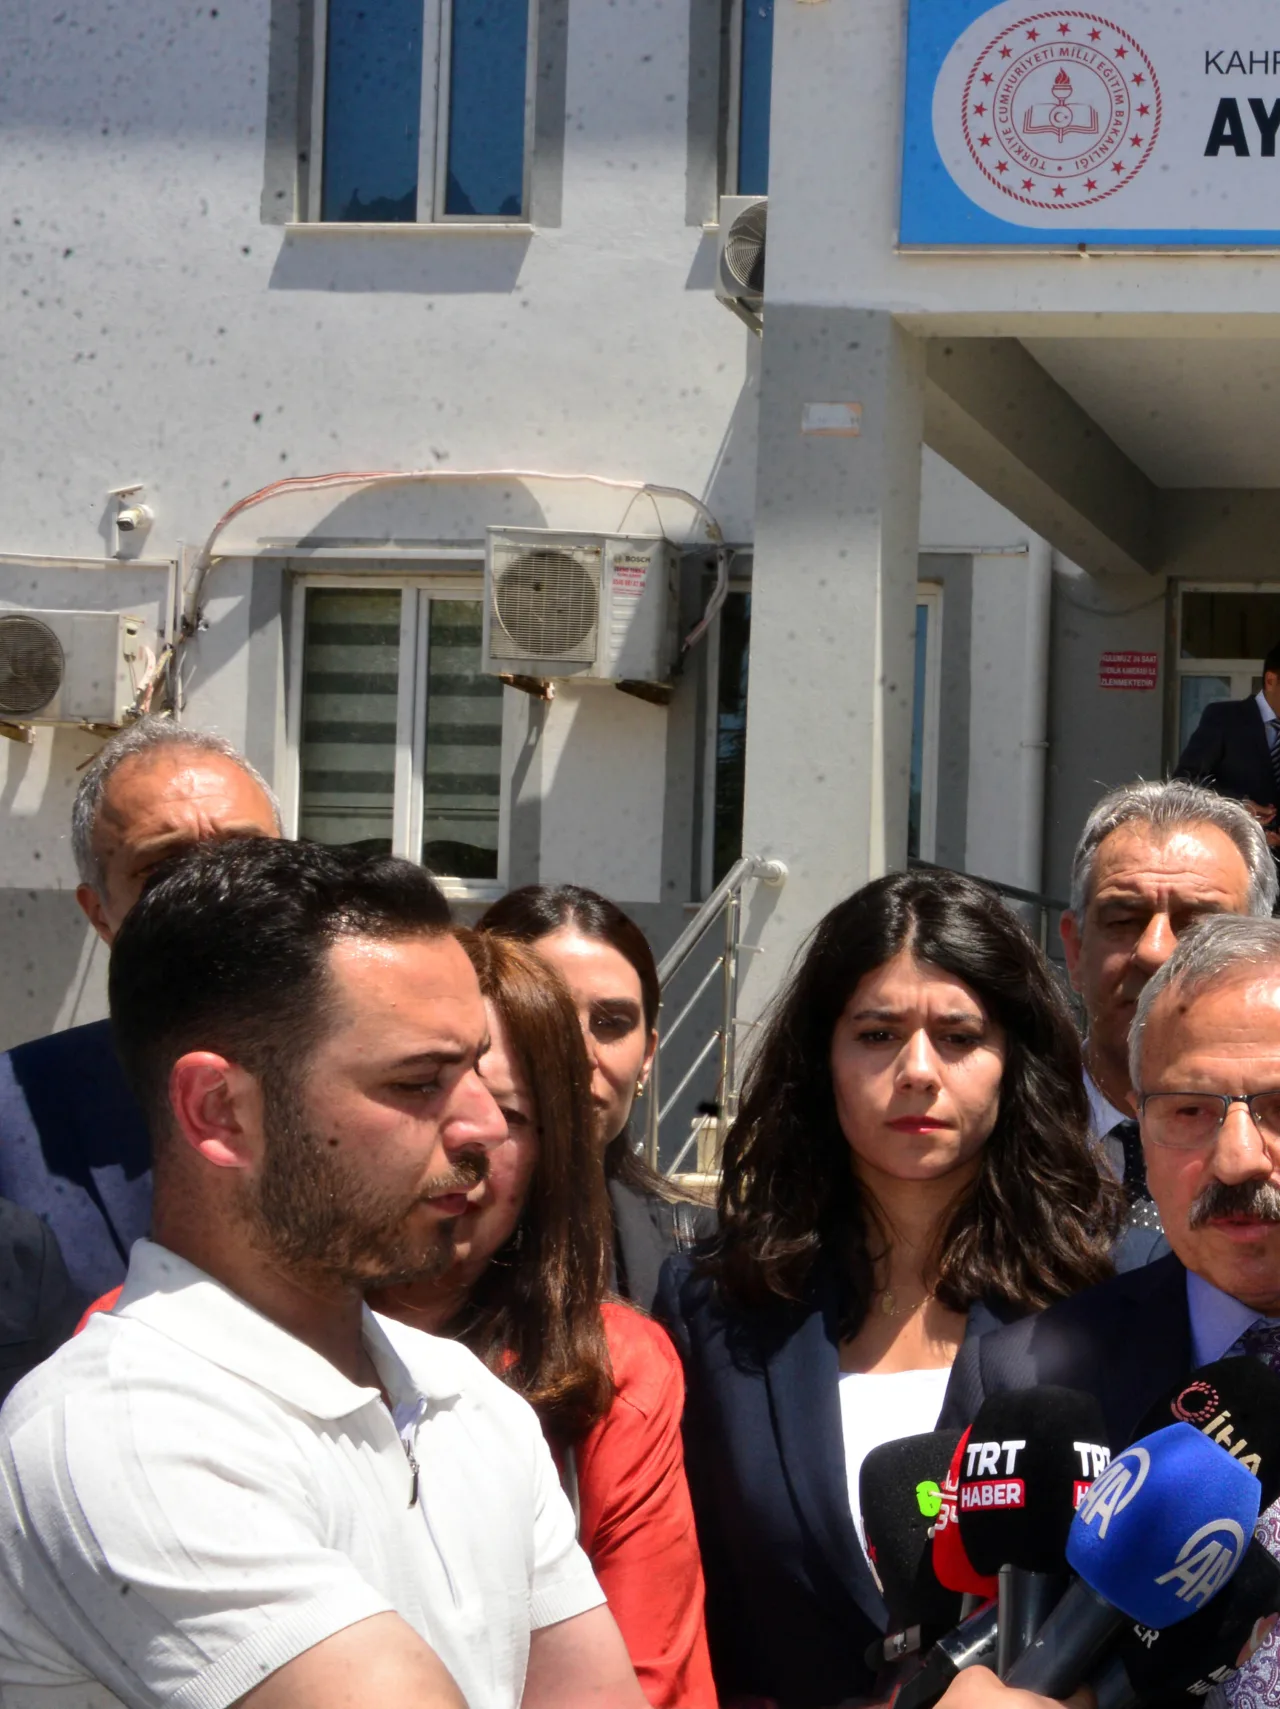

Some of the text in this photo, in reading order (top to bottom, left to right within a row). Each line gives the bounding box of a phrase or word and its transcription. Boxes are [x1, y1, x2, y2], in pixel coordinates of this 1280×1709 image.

[998, 46, 1125, 171] TÜRKİYE CUMHURİYETİ MİLLİ EĞİTİM BAKANLIĞI
[625, 555, 651, 563] BOSCH
[967, 1440, 1026, 1477] TRT
[962, 1483, 1021, 1508] HABER
[1154, 1538, 1233, 1609] AA
